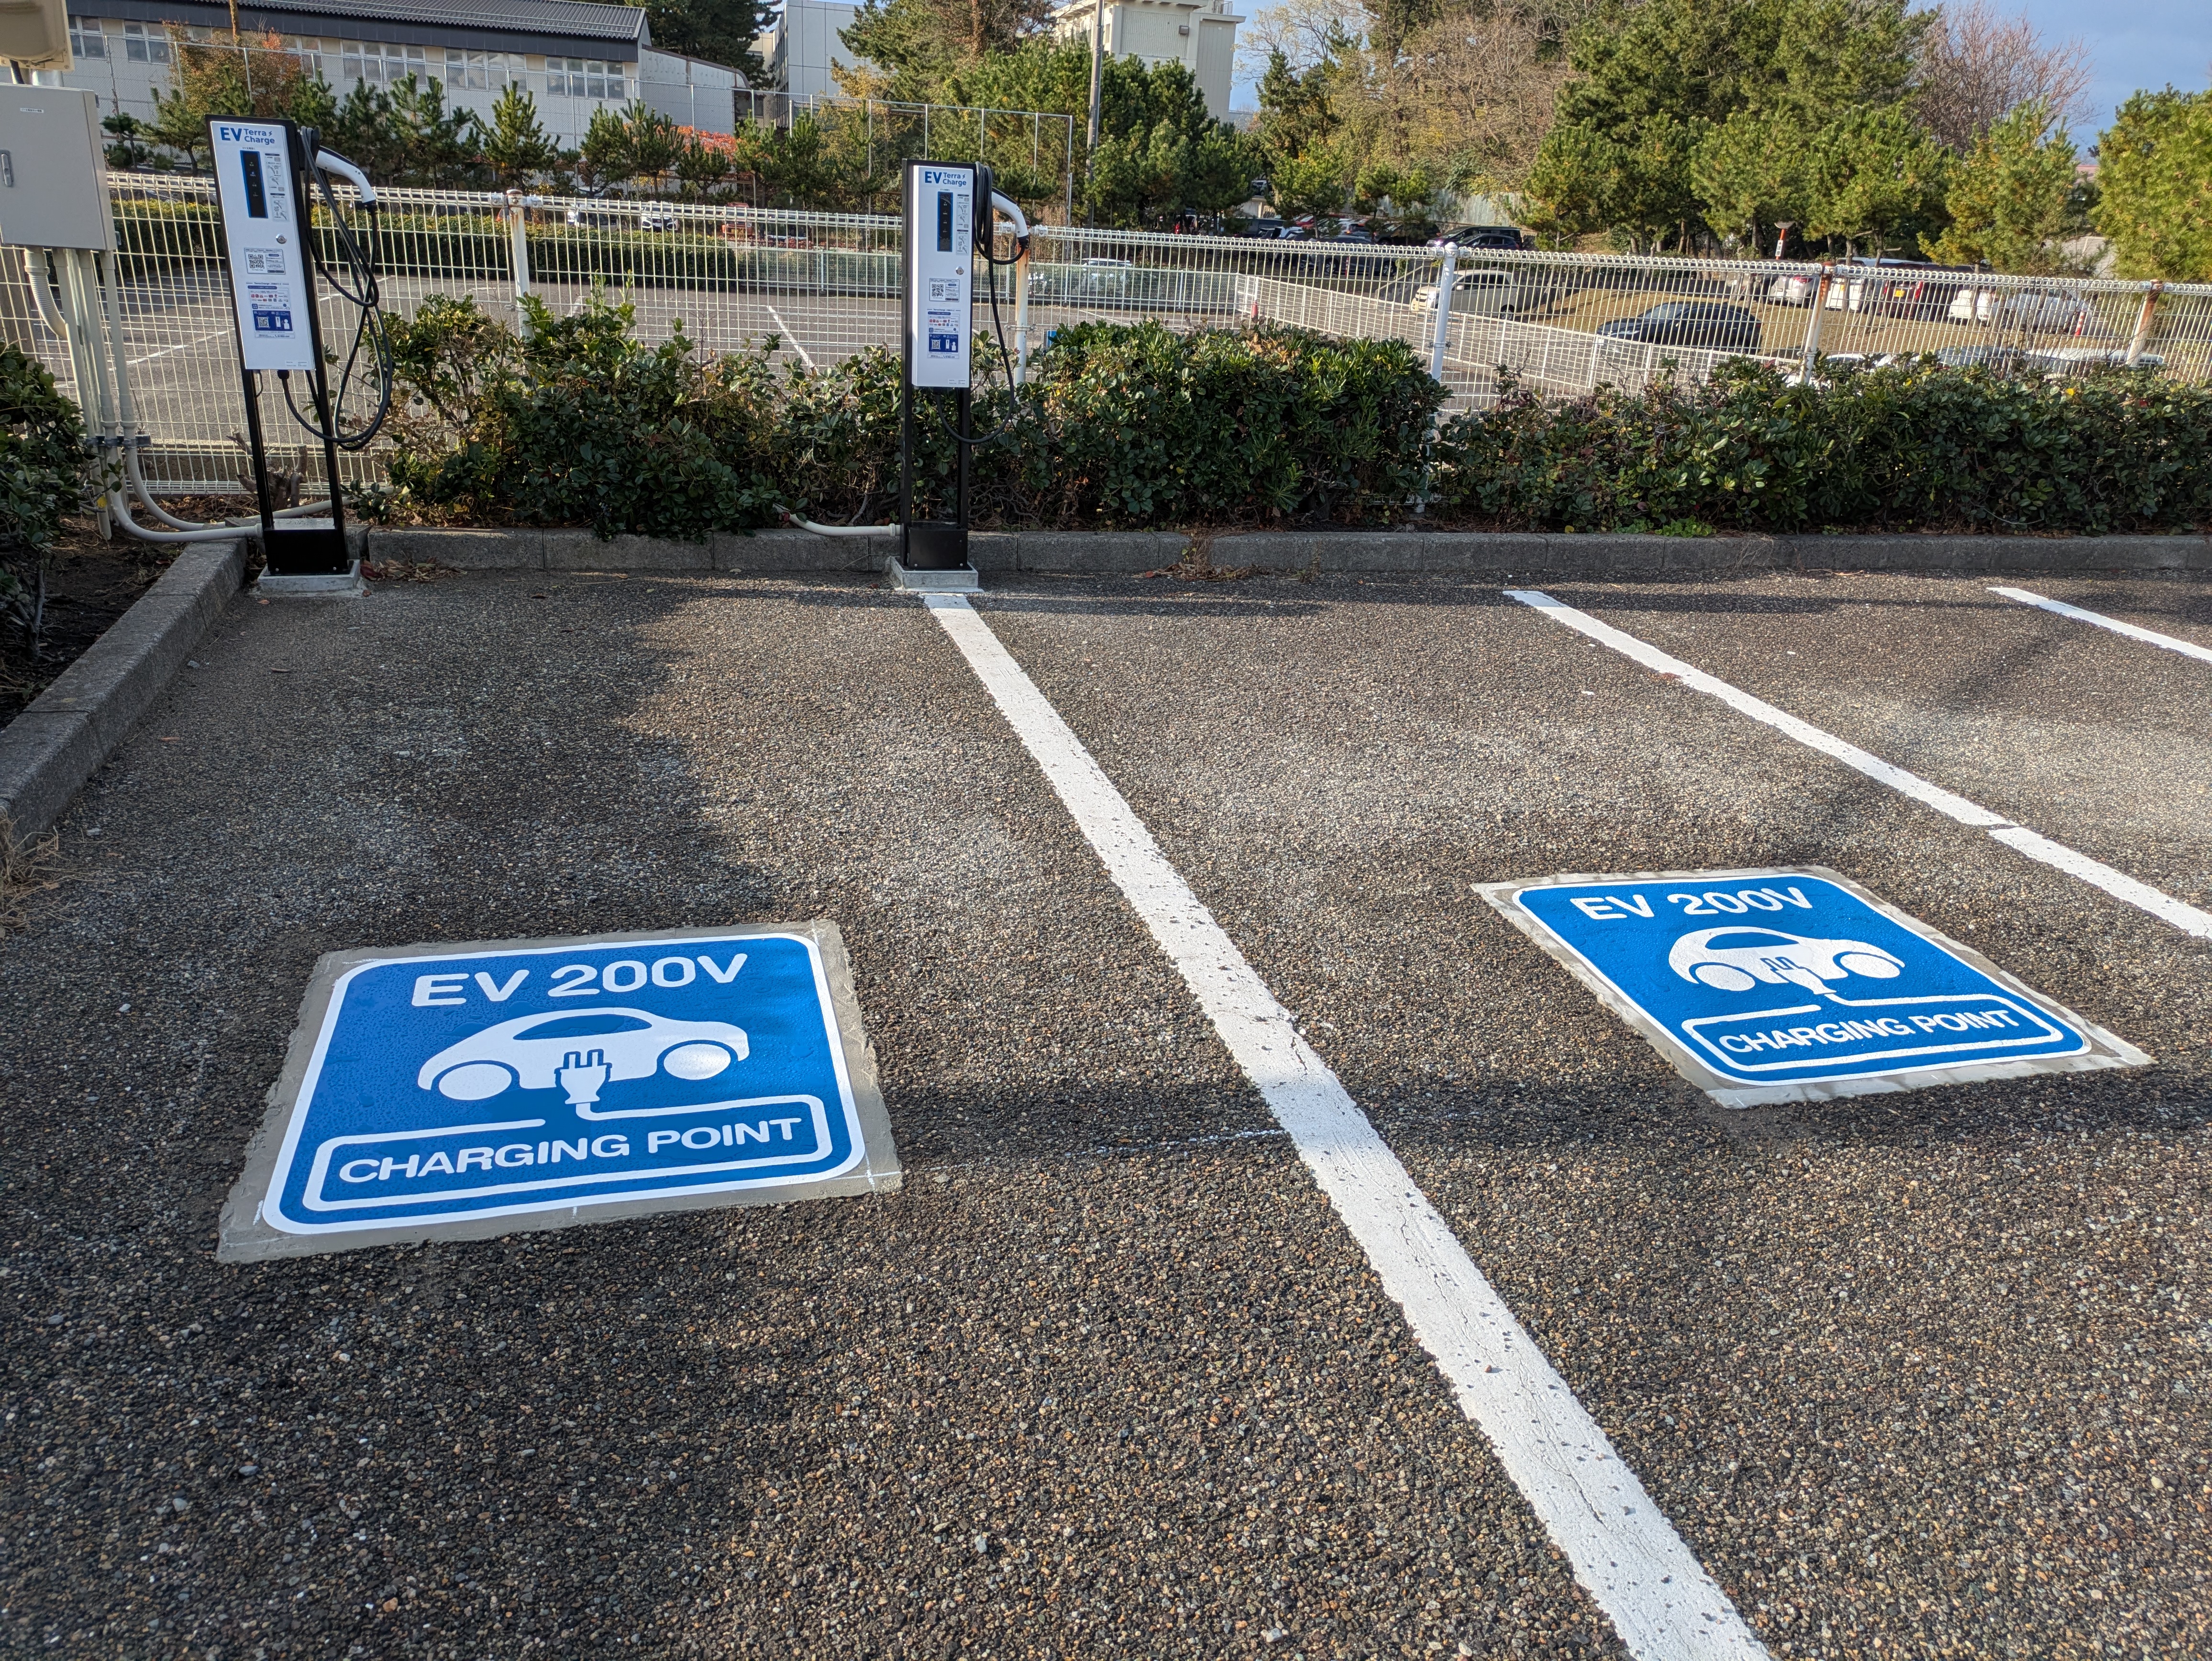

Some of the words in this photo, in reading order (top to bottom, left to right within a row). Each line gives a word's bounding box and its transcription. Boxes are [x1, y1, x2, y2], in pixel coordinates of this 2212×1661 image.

[220, 127, 242, 141] EV
[244, 136, 275, 145] Charge
[925, 171, 942, 184] EV
[942, 179, 967, 187] Charge
[1570, 895, 1654, 919] EV
[1667, 887, 1812, 915] 200V
[412, 970, 529, 1007] EV
[548, 953, 748, 997] 200V
[1719, 1018, 1914, 1052] CHARGING
[1908, 1010, 2019, 1033] POINT
[339, 1134, 630, 1183] CHARGING
[648, 1118, 802, 1153] POINT
